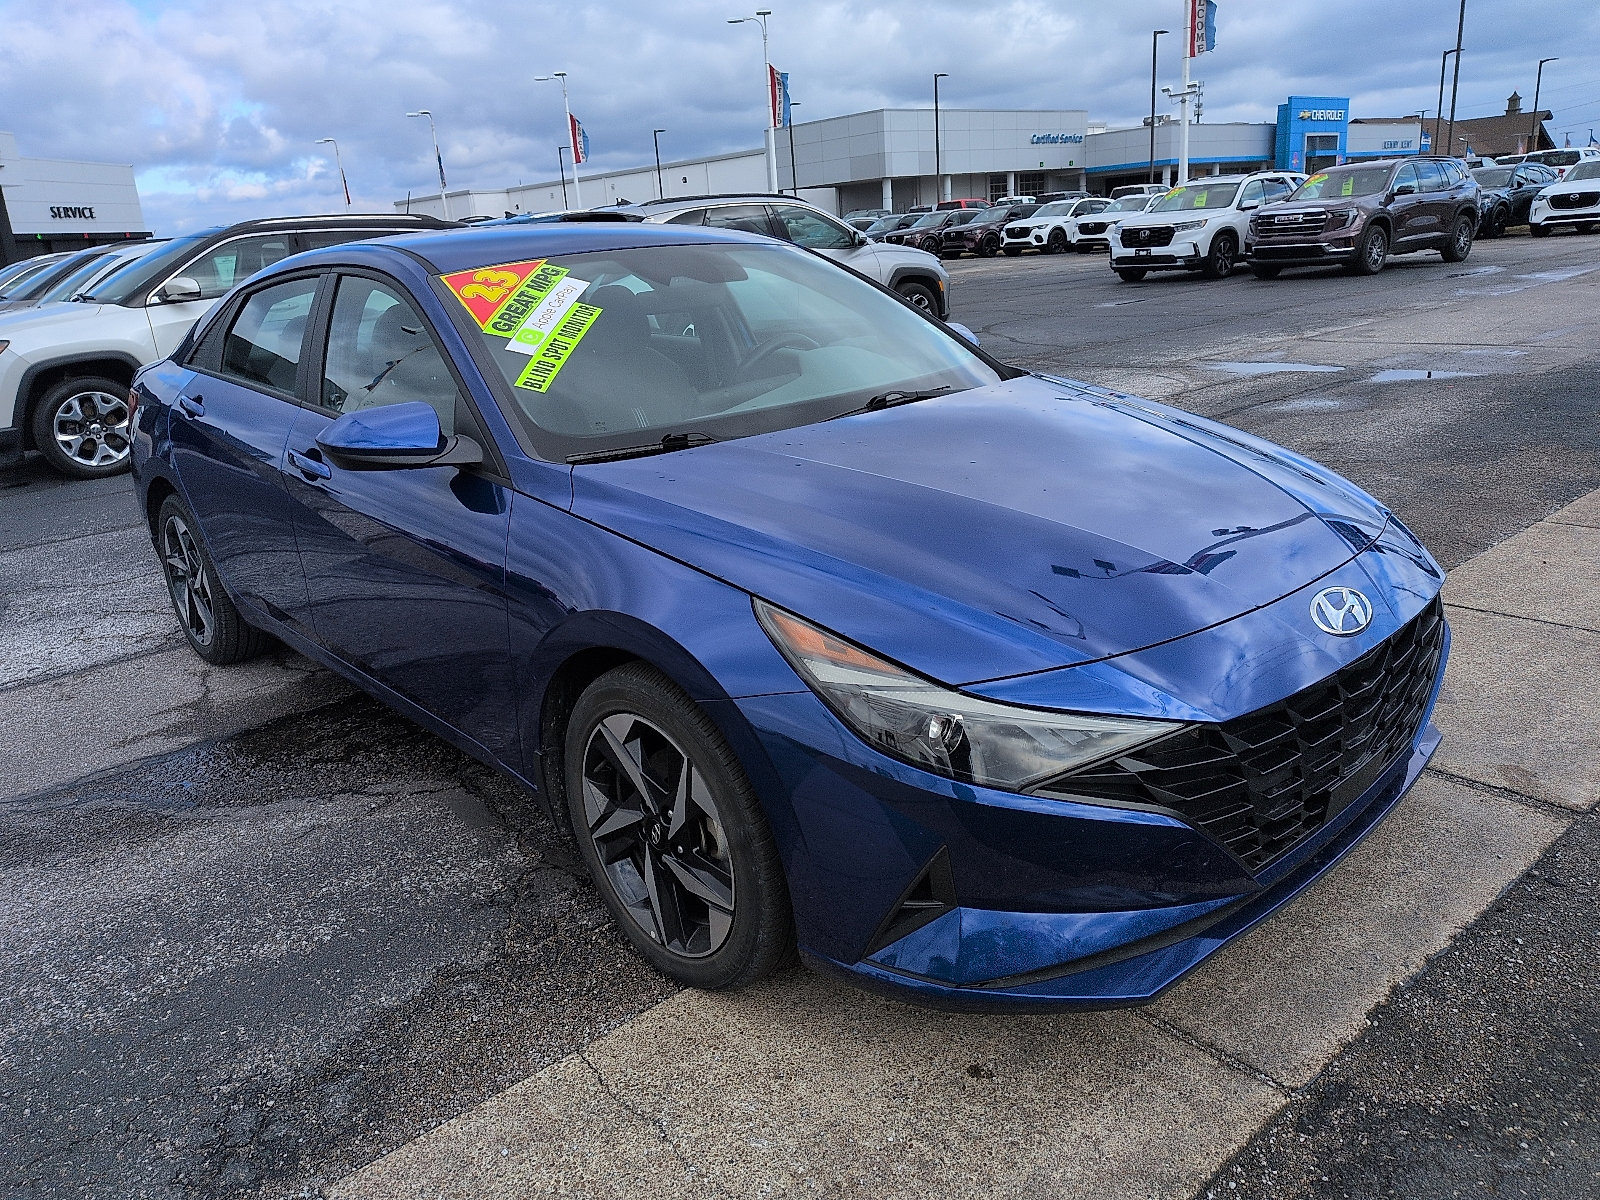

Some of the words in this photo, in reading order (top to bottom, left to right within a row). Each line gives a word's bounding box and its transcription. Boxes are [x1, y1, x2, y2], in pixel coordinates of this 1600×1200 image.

[1311, 110, 1346, 121] CHEVROLET
[1031, 133, 1060, 144] Certified
[1060, 133, 1083, 144] Service
[50, 206, 96, 219] SERVICE
[460, 269, 520, 303] 23
[491, 290, 538, 333] GREAT
[525, 267, 561, 293] MPG
[532, 307, 557, 329] Apple
[553, 284, 578, 310] CarPlay
[522, 359, 556, 390] BLIND
[541, 337, 572, 361] SPOT
[557, 303, 598, 340] MONITOR
